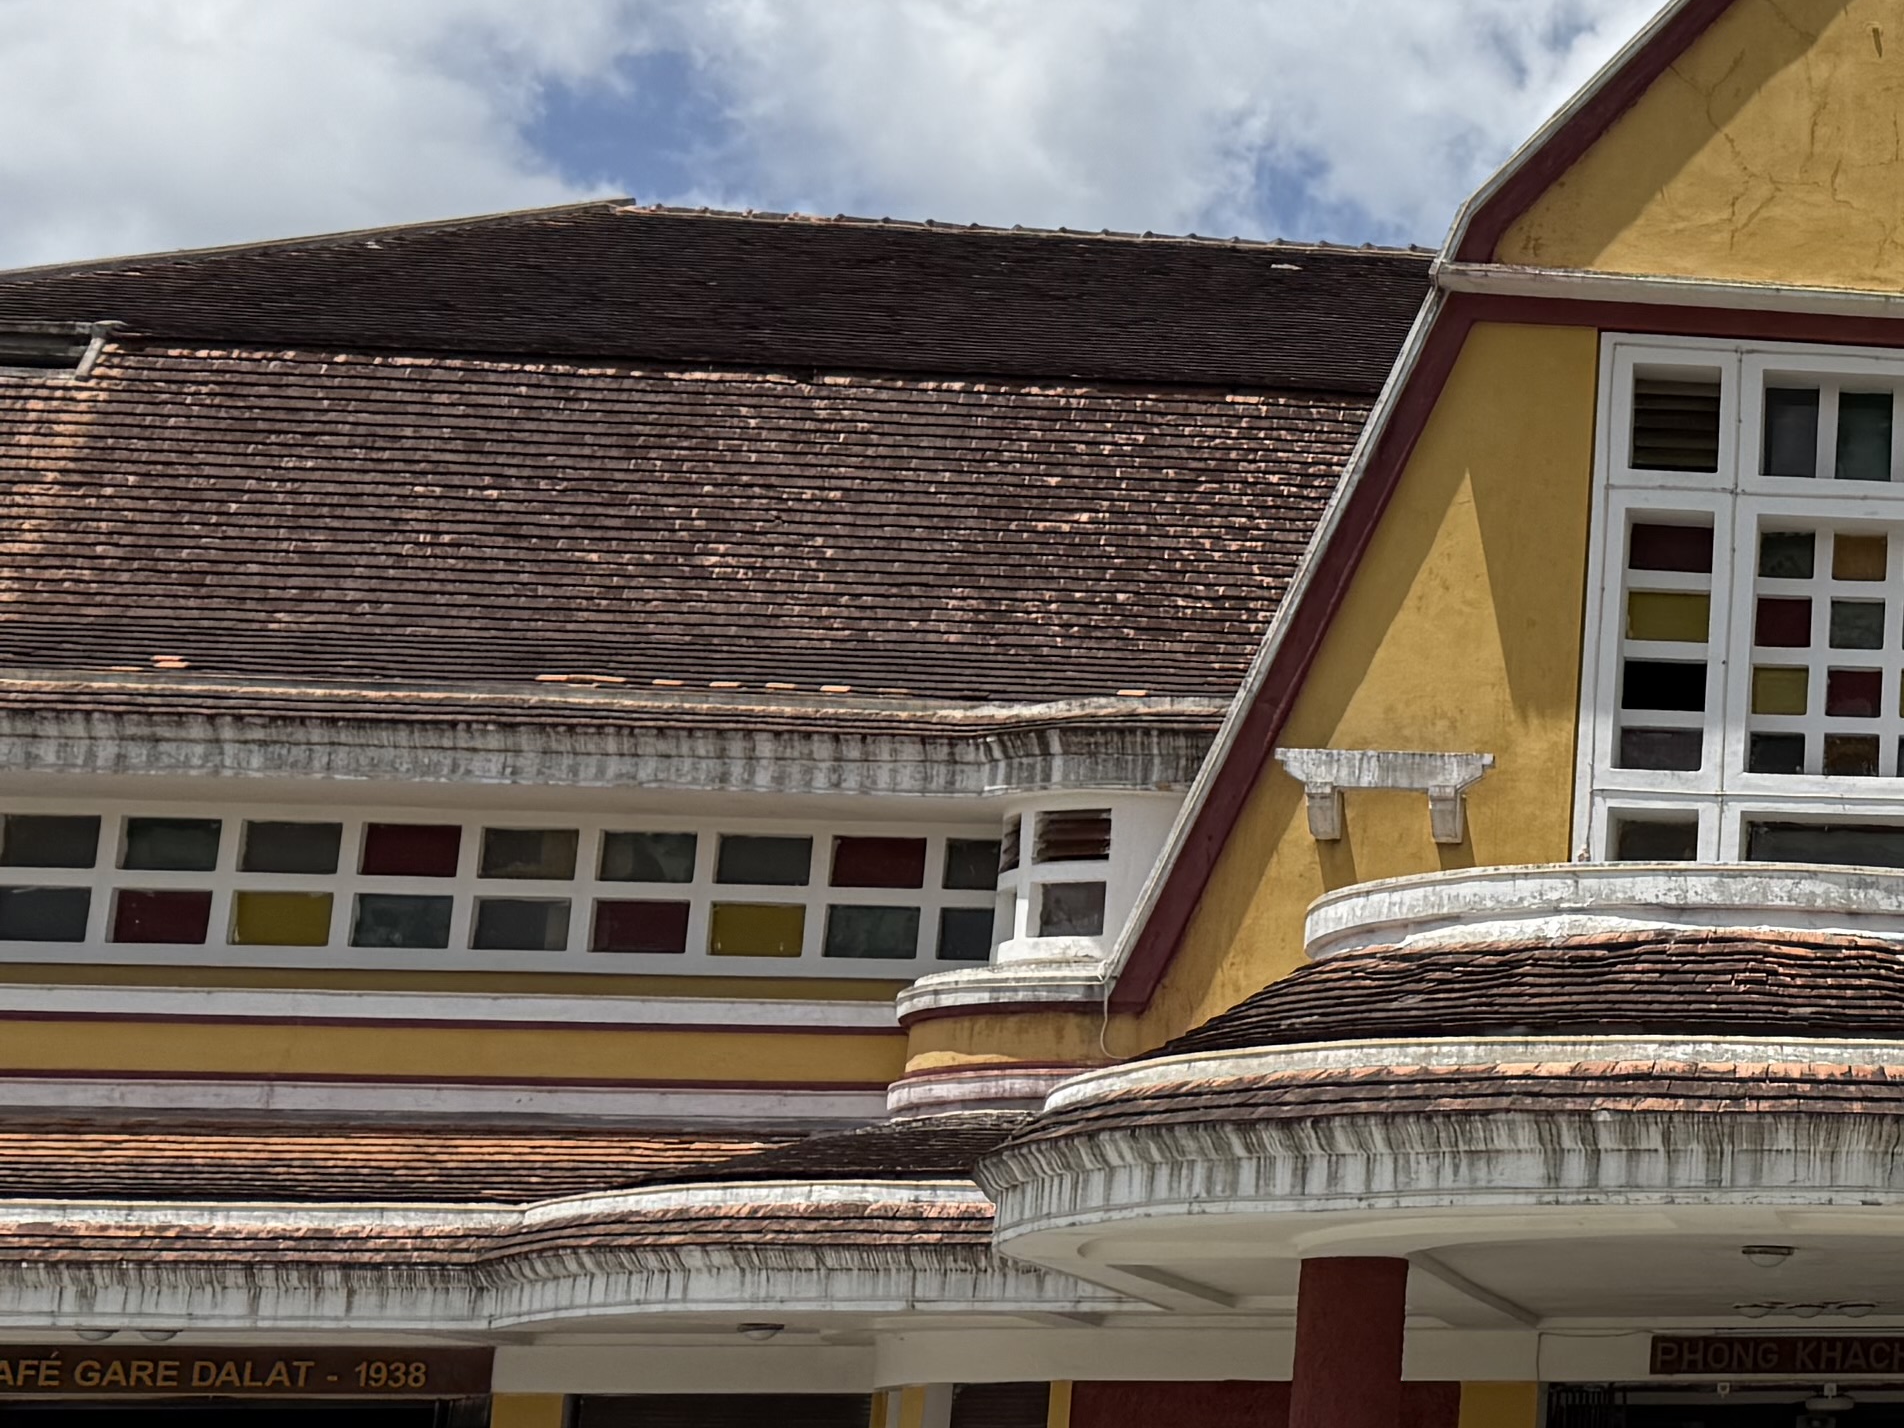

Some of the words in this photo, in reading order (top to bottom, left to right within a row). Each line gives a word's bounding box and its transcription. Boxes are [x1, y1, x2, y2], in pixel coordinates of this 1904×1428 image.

[1656, 1340, 1779, 1371] PHONG
[74, 1360, 180, 1387] GARE
[191, 1360, 314, 1387] DALAT
[354, 1361, 427, 1388] 1938
